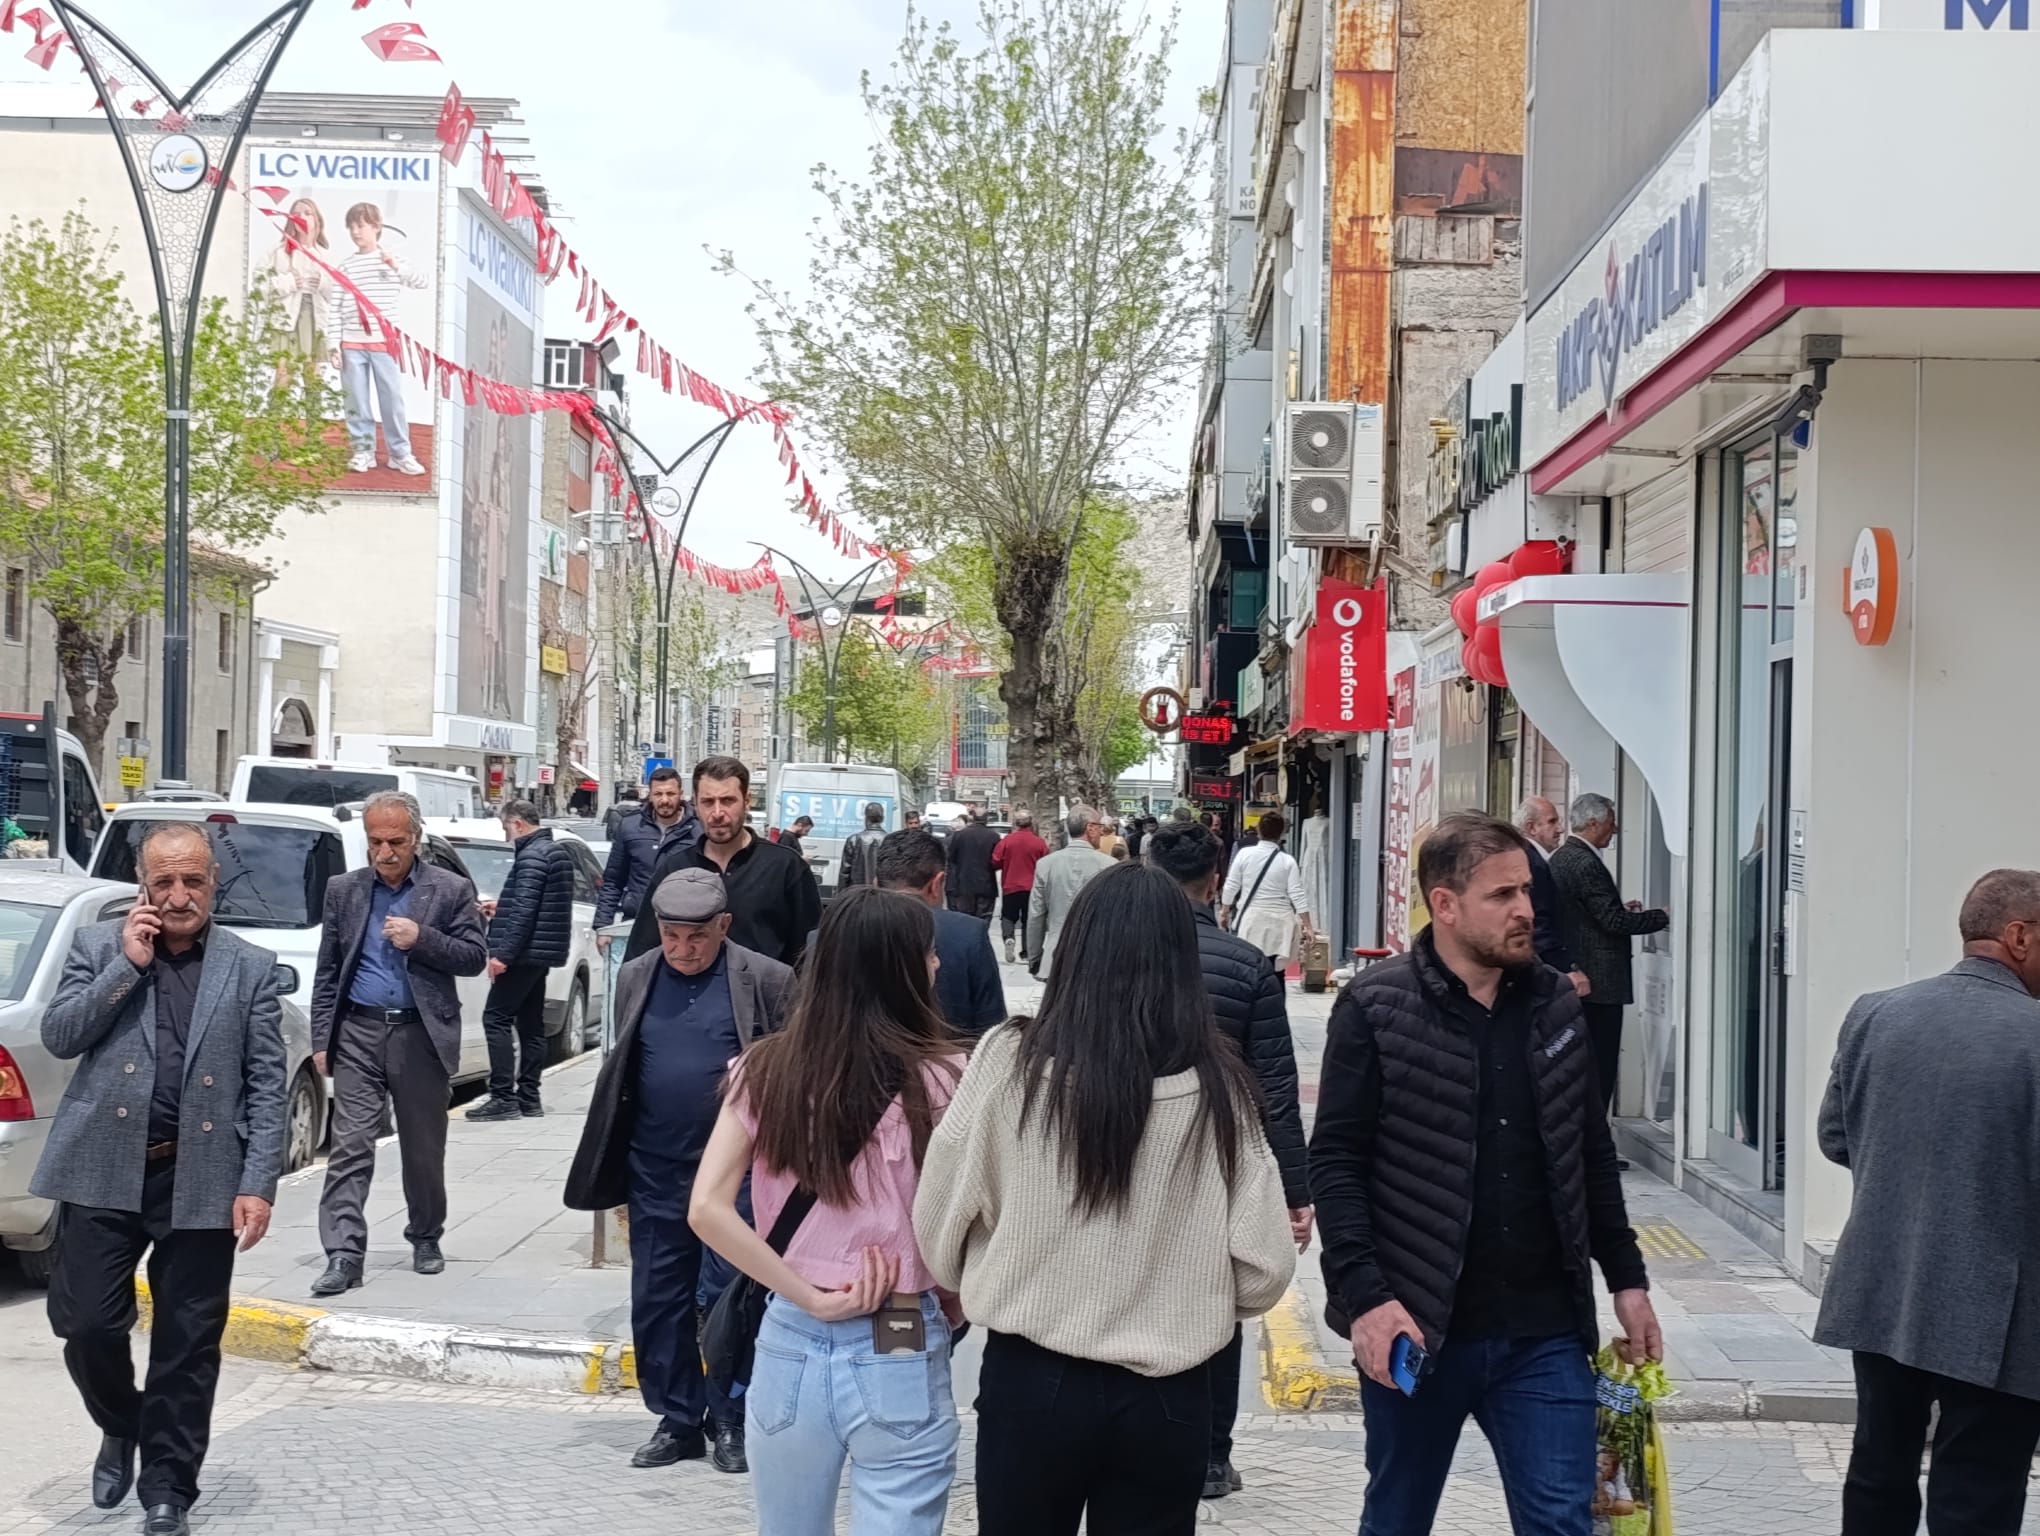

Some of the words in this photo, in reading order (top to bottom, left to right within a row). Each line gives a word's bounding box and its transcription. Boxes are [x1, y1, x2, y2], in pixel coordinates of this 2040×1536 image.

[259, 153, 299, 178] LC
[469, 214, 486, 272] LC
[1340, 630, 1357, 721] vodafone
[541, 770, 550, 780] E
